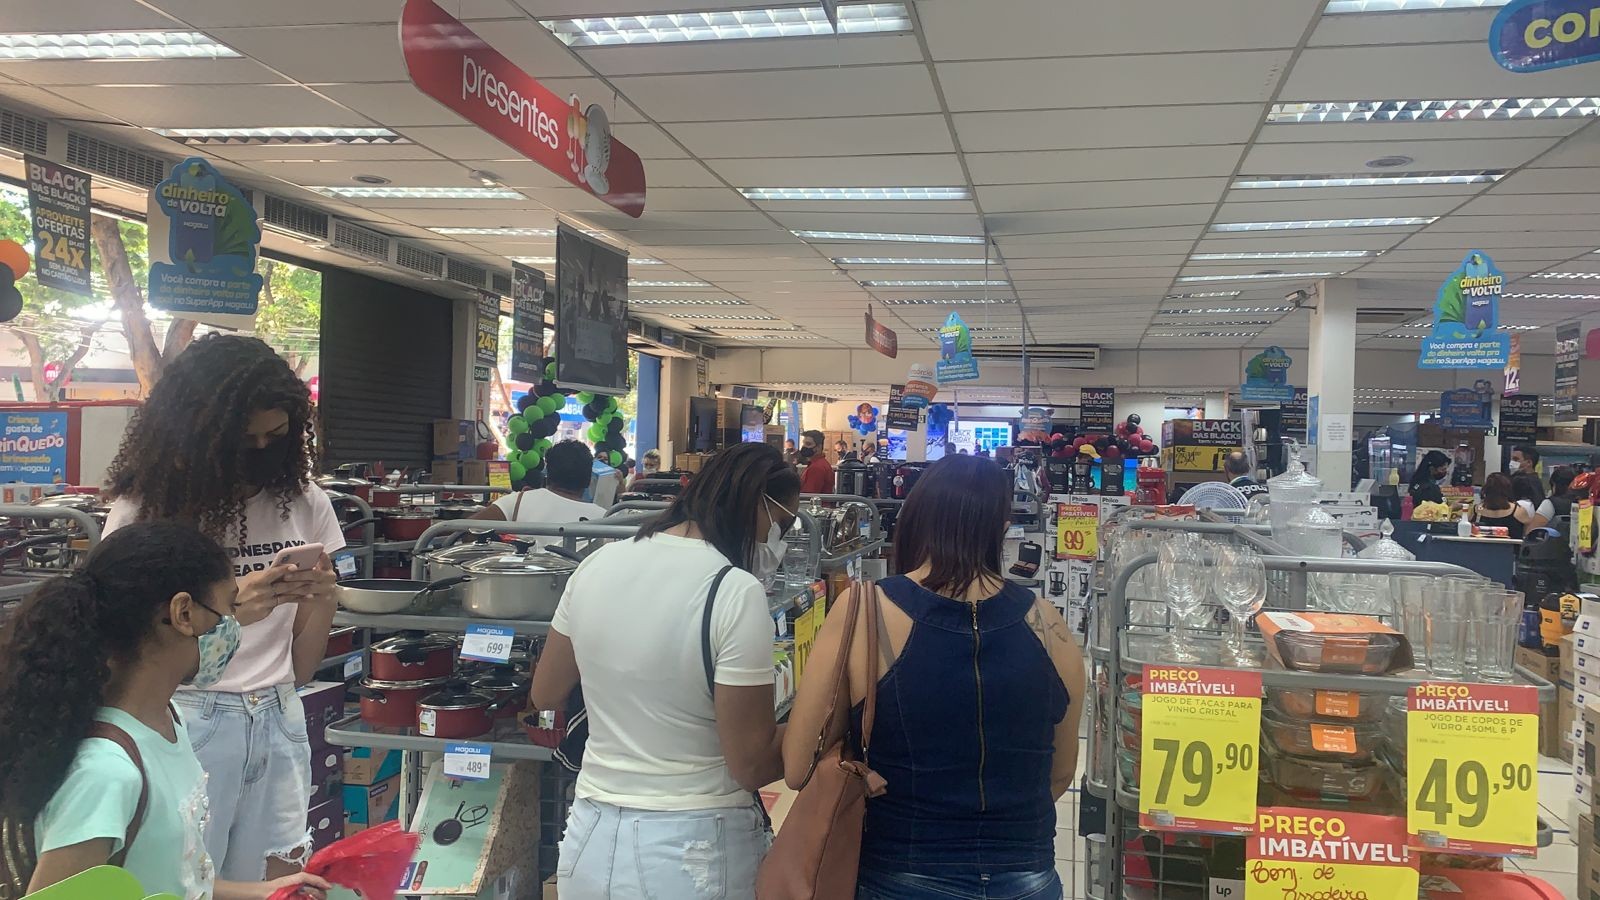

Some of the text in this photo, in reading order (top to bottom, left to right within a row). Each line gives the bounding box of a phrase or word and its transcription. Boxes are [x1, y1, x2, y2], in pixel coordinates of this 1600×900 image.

[462, 54, 558, 150] presentes
[29, 162, 86, 194] BLACK
[31, 182, 49, 195] DAS
[50, 189, 86, 206] BLACKS
[162, 183, 228, 204] dinheiro
[167, 199, 178, 208] de
[35, 207, 85, 228] APROVEITE
[36, 216, 85, 240] OFERTAS
[161, 273, 184, 284] Você
[185, 278, 219, 289] compra
[1460, 273, 1502, 288] dinheiro
[515, 283, 544, 306] BLACK
[186, 296, 224, 308] SuperApp
[1445, 358, 1476, 366] SuperApp
[1082, 392, 1113, 400] BLACK
[1502, 400, 1536, 408] BLACK
[6, 424, 43, 434] gosta de
[1193, 422, 1241, 432] BLACK
[1237, 484, 1268, 494] agalu
[1064, 530, 1084, 550] 99
[487, 642, 503, 654] 699
[1150, 670, 1198, 682] PREÇO
[1150, 681, 1234, 694] IMBATÍVEL!
[1416, 686, 1468, 700] PREÇO
[1228, 702, 1253, 710] PARA
[1416, 697, 1509, 712] IMBATÍVEL!
[1168, 706, 1237, 717] VINHO CRISTAL
[1424, 714, 1451, 722] JOGO
[1472, 716, 1506, 726] COPOS
[1510, 718, 1522, 726] DE
[1431, 723, 1462, 731] VIDRO
[1466, 725, 1498, 734] 450ML
[467, 762, 482, 772] 489
[1260, 815, 1345, 840] PREÇO
[1260, 836, 1408, 862] IMBATÍVEL!
[1313, 865, 1335, 880] de
[1216, 886, 1231, 896] up
